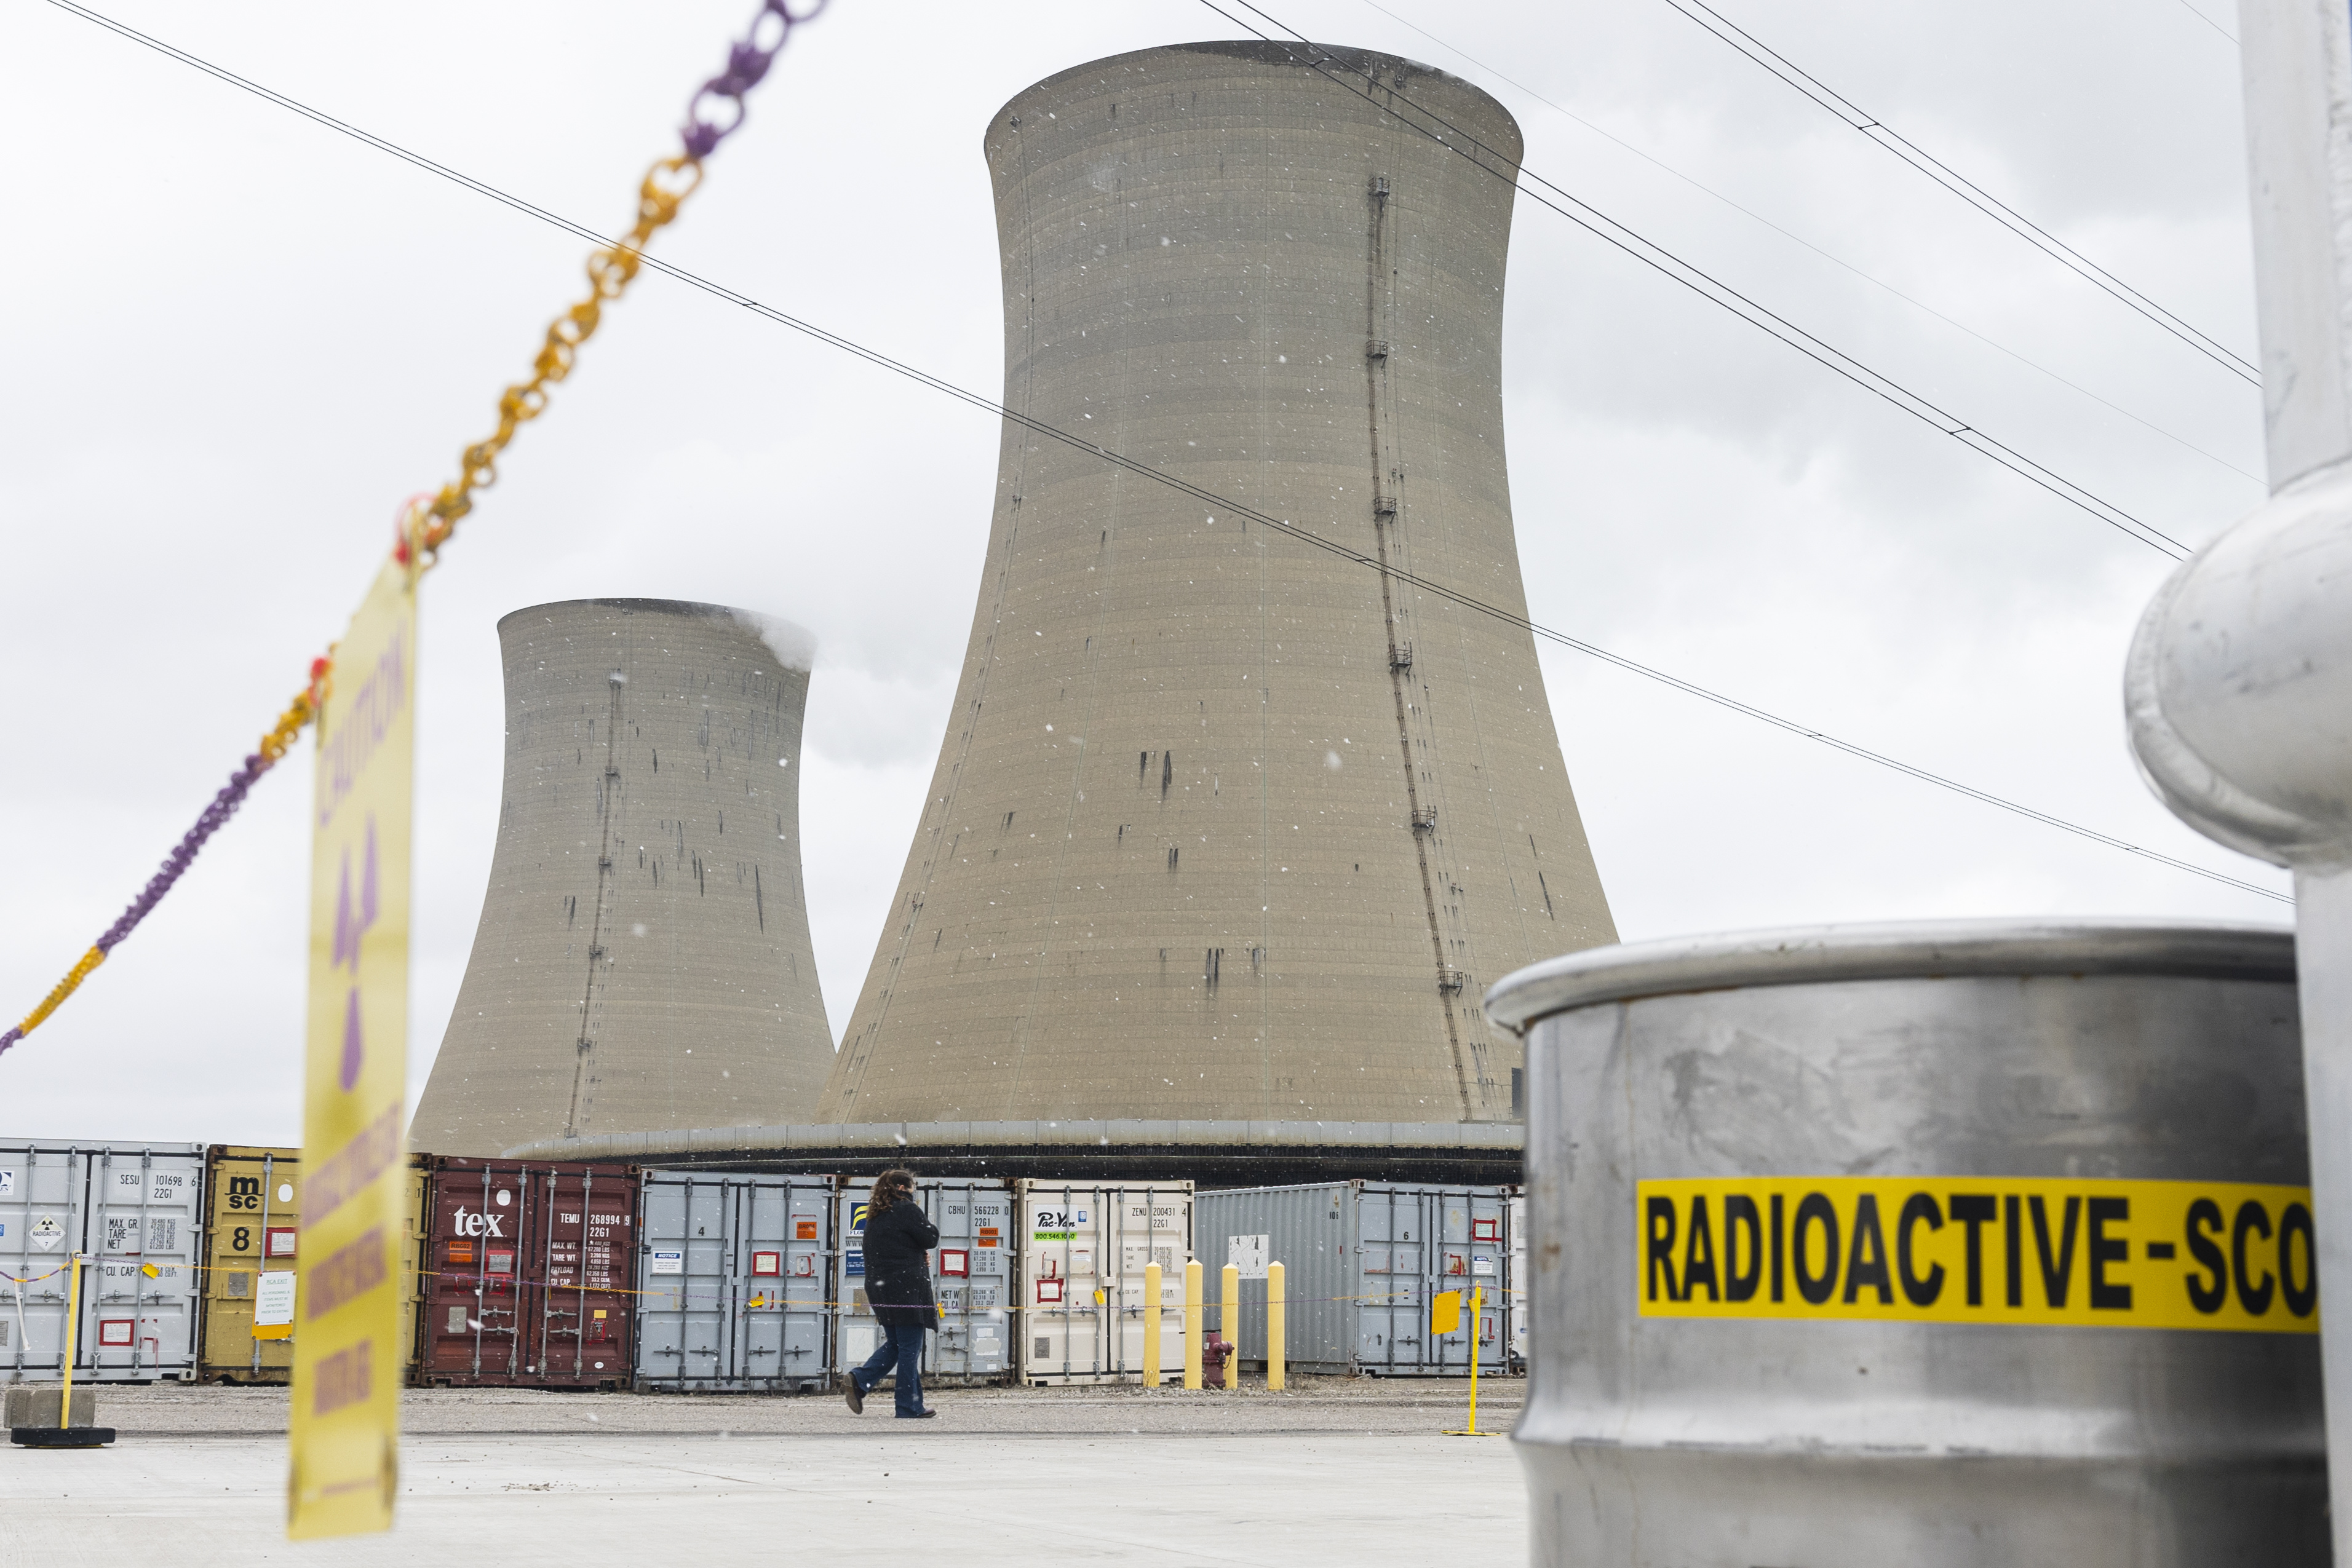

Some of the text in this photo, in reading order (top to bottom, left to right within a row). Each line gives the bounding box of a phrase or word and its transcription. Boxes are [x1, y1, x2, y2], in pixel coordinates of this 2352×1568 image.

[120, 1174, 196, 1186] SESU 101698 6
[154, 1188, 172, 1198] 22G1
[948, 1205, 966, 1214] CBHU
[974, 1206, 999, 1215] 566228
[1132, 1207, 1186, 1216] ZENU 200431 4
[560, 1213, 630, 1225] TEMU 268994 9
[974, 1218, 990, 1227] 22G1
[1153, 1219, 1168, 1228] 22G1
[108, 1229, 127, 1239] TARE
[589, 1227, 610, 1238] 22G1
[698, 1227, 705, 1236] 4
[1404, 1231, 1409, 1240] 6
[107, 1239, 121, 1249] NET
[232, 1227, 250, 1251] 8
[106, 1266, 137, 1277] CU. CAP.
[941, 1290, 952, 1299] NET
